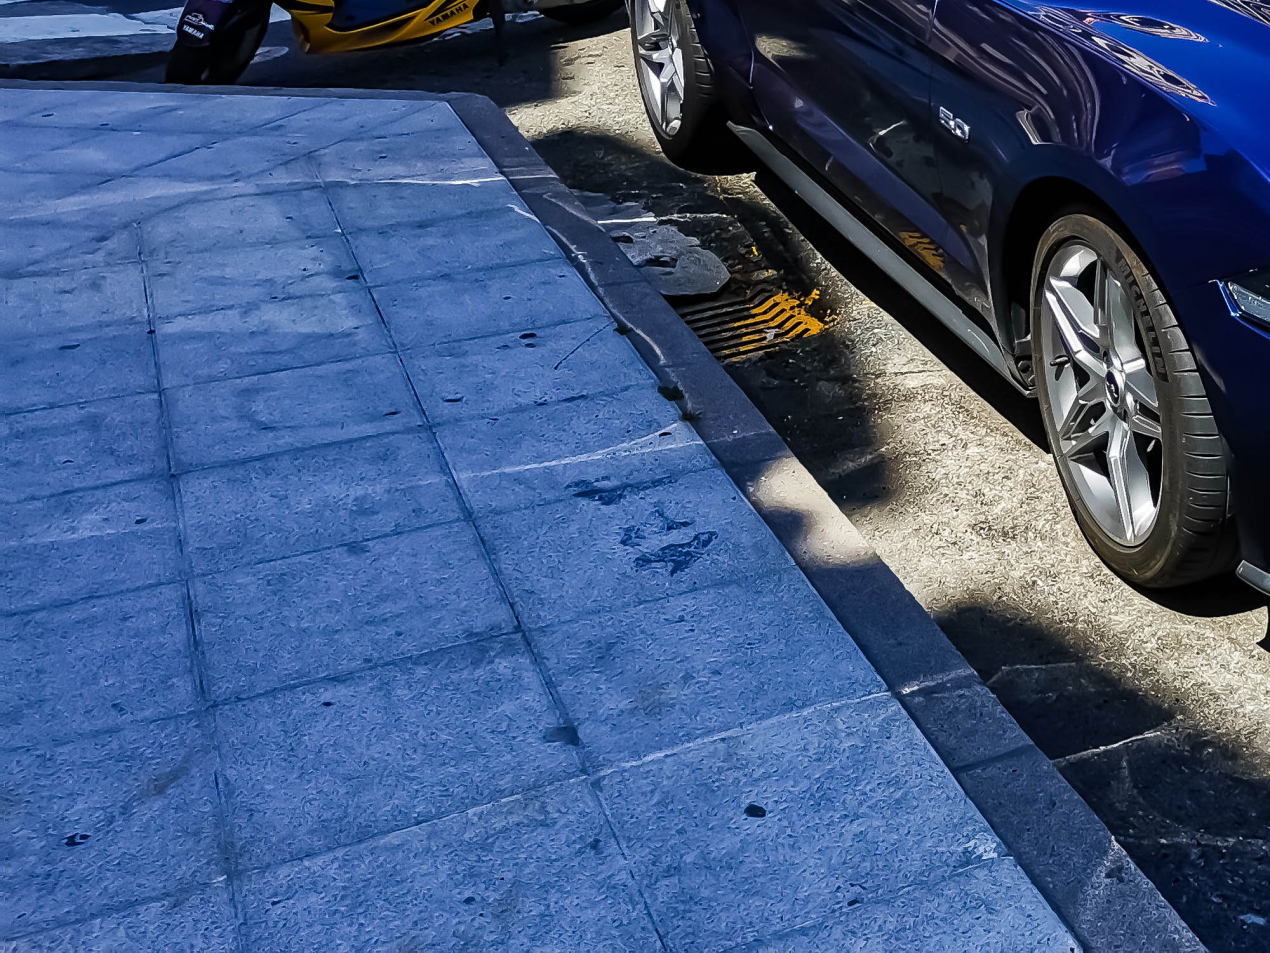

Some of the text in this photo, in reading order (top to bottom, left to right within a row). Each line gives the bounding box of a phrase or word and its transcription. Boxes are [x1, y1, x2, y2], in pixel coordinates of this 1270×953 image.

[428, 3, 469, 27] YAMAHA
[183, 24, 205, 39] YAMAHA
[1115, 256, 1169, 376] MICHELIN
